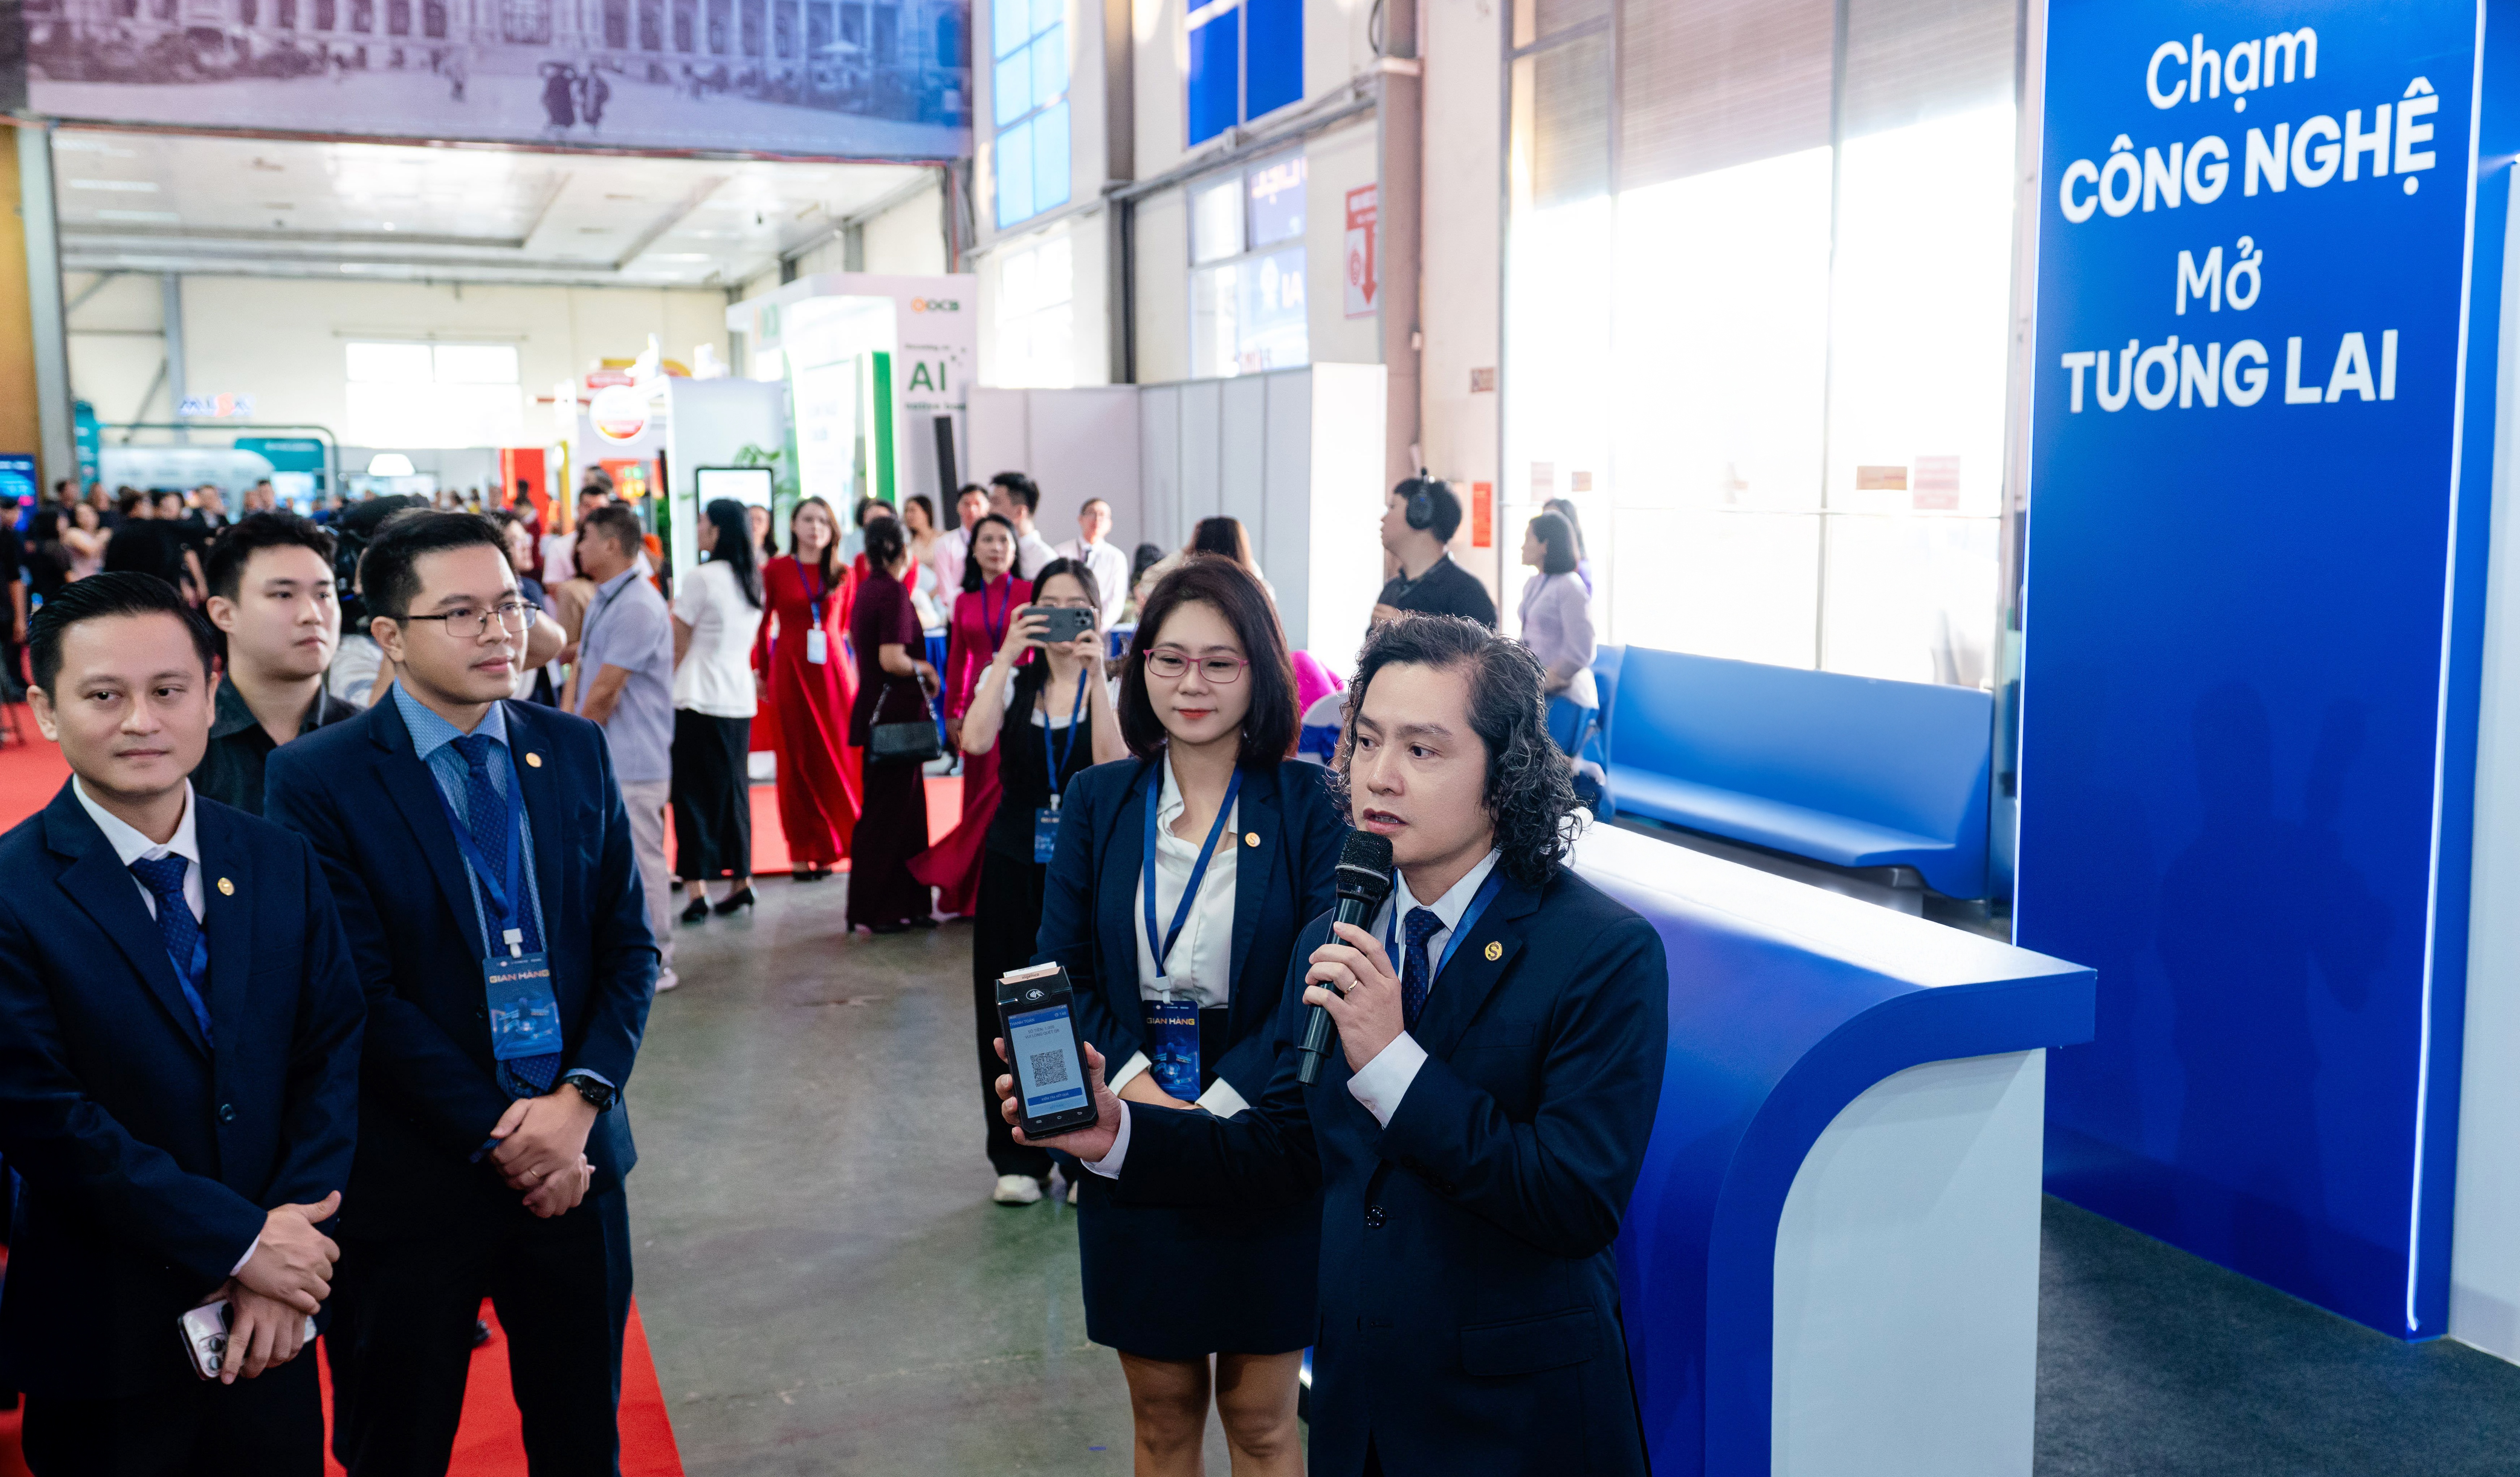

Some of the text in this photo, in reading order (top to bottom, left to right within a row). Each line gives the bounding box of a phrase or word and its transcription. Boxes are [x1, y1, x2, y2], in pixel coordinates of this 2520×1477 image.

[2146, 26, 2318, 113] Chạm
[2059, 76, 2439, 224] CÔNG NGHỆ
[2176, 235, 2263, 316] Mở
[909, 361, 946, 391] AI
[2060, 329, 2398, 414] TƯƠNG LAI
[489, 973, 517, 984] GIAN
[1169, 1016, 1195, 1025] HÀNG
